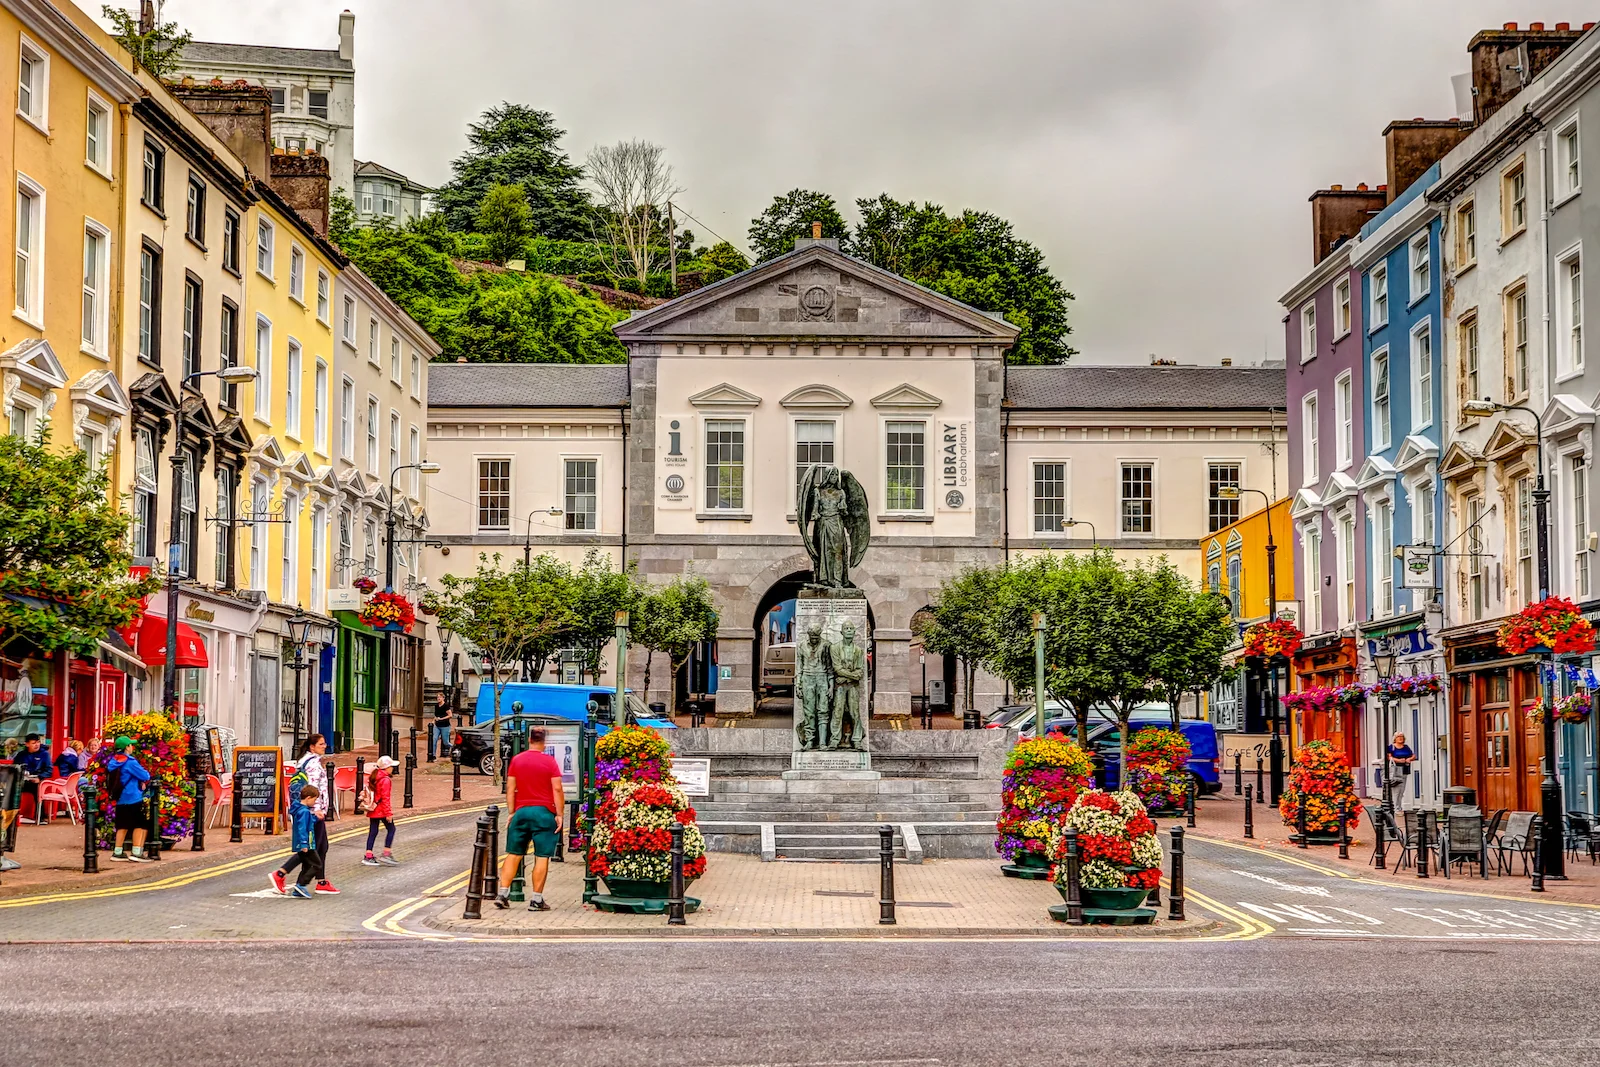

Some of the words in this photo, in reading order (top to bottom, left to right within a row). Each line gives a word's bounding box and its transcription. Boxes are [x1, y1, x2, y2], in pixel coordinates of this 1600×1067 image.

[944, 424, 956, 486] LIBRARY
[959, 424, 967, 486] Leabharlann
[1226, 747, 1251, 757] CAFÉ
[1236, 901, 1383, 924] NO
